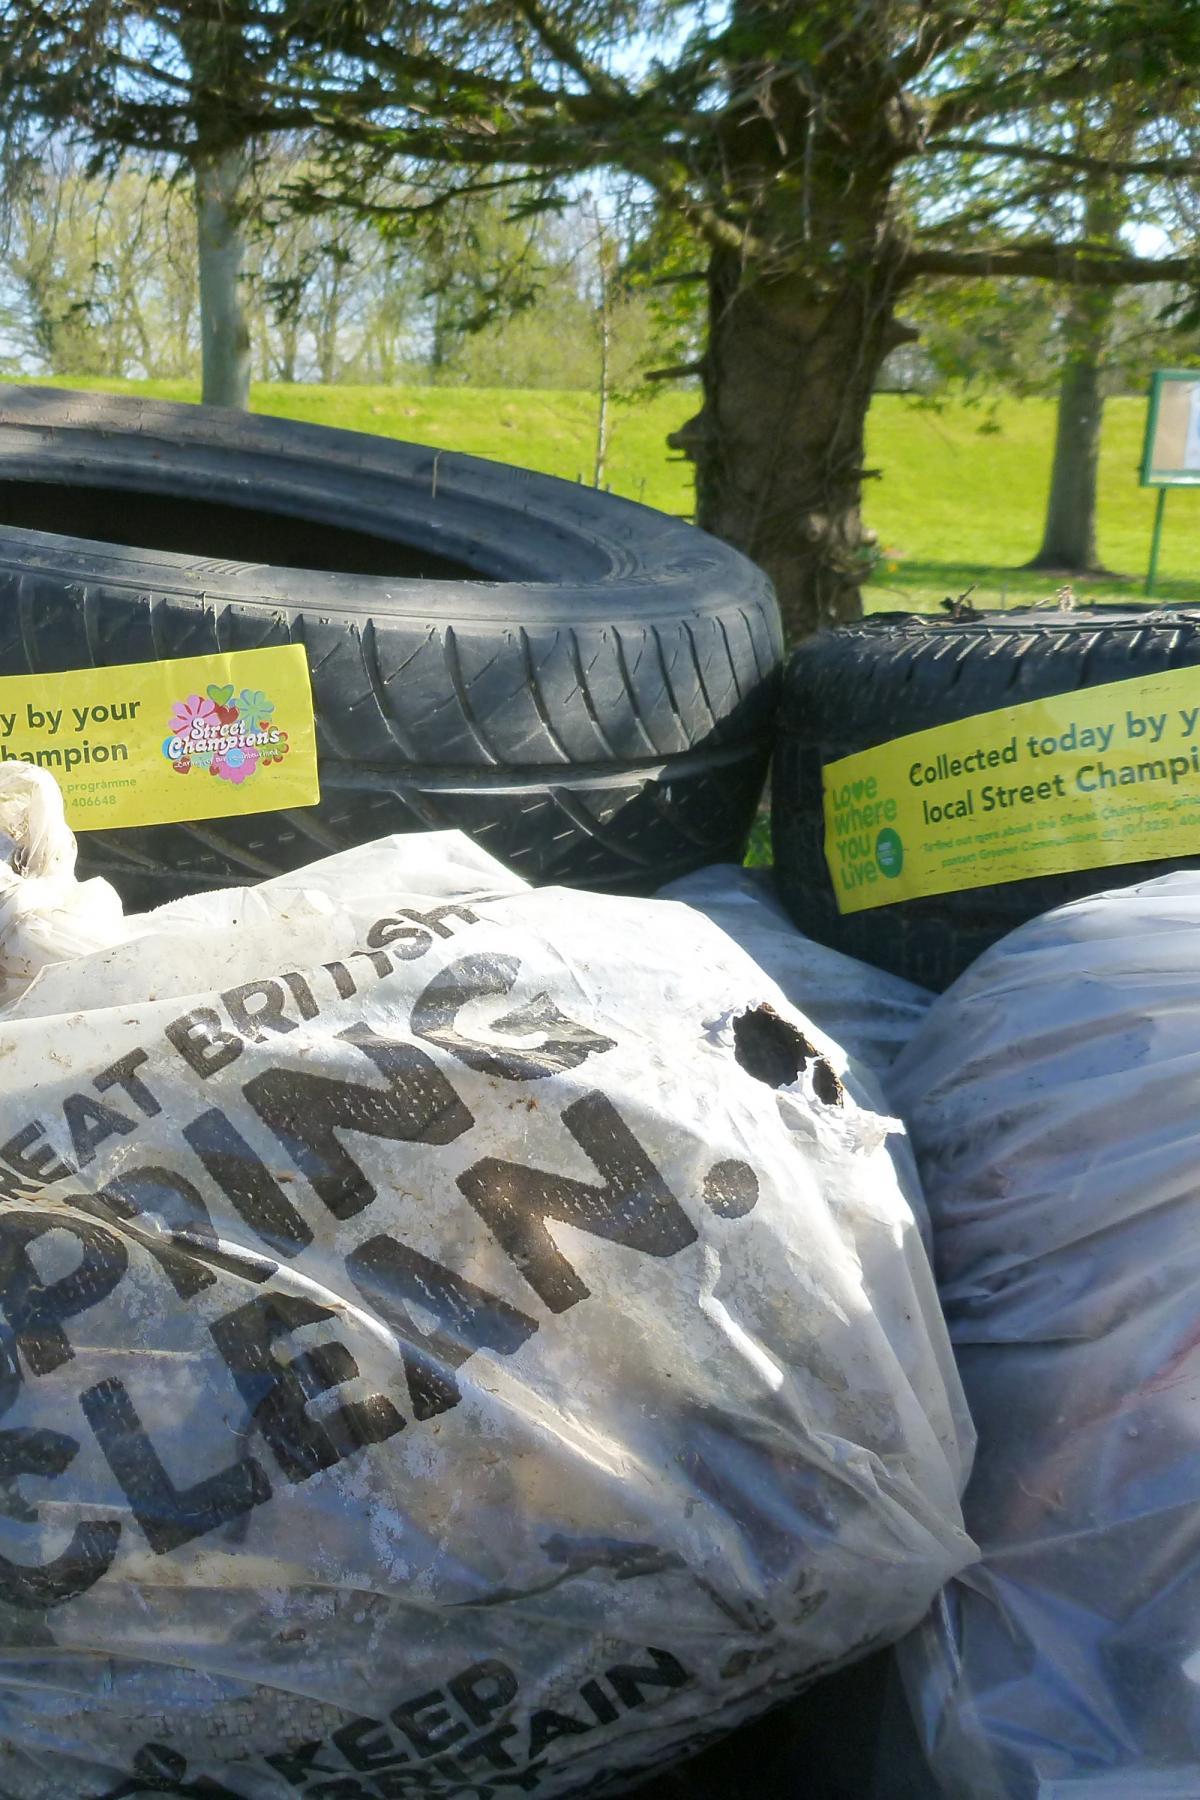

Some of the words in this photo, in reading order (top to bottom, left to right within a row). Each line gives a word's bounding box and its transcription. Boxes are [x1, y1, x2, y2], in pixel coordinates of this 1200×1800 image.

[26, 703, 63, 735] by
[72, 700, 141, 732] your
[190, 717, 247, 741] Street
[167, 729, 282, 761] Champions
[910, 736, 1018, 787] Collected
[1026, 722, 1115, 759] today
[1125, 710, 1168, 744] by
[66, 777, 137, 796] programme
[71, 794, 118, 809] 406648
[923, 789, 974, 825] local
[981, 774, 1067, 812] Street
[1075, 745, 1200, 793] Champi
[163, 904, 481, 1081] BRITISH
[263, 1657, 519, 1786] KEEP
